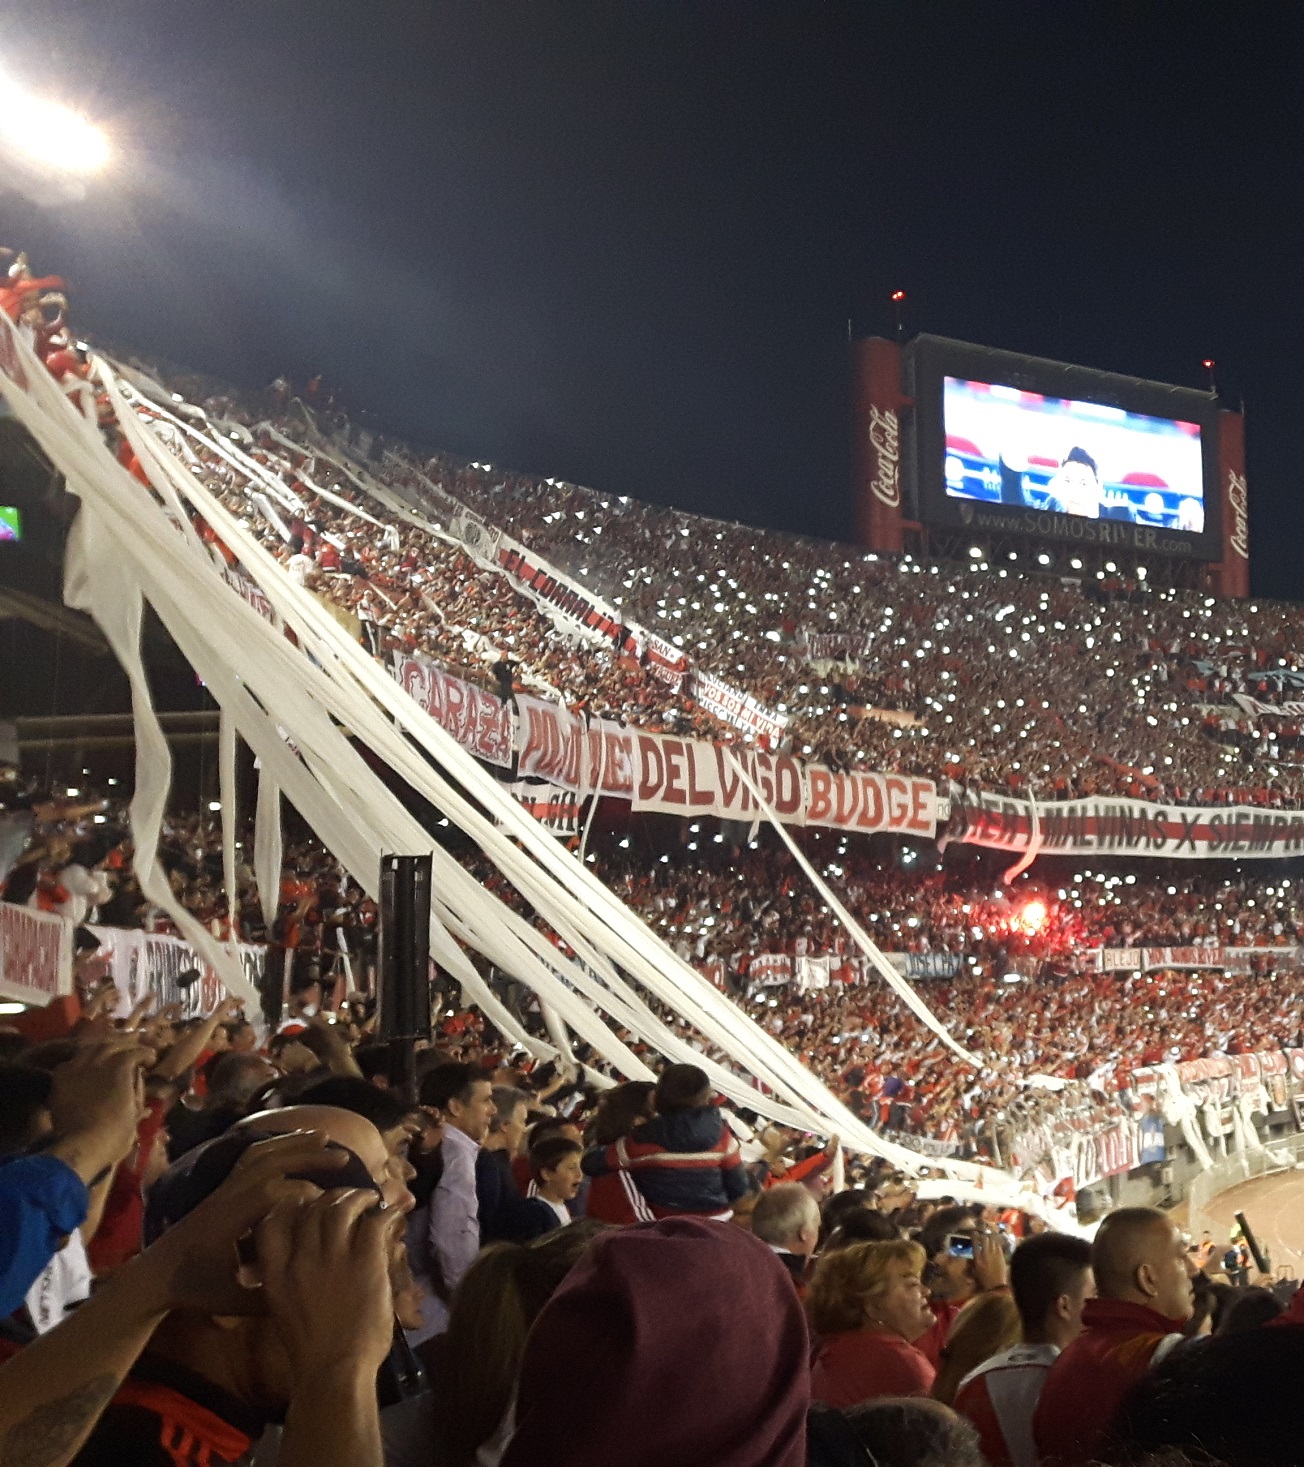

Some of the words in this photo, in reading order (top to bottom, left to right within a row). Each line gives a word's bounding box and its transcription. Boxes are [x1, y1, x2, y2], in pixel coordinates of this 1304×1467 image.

[703, 683, 721, 702] VOS
[721, 693, 741, 713] SOS
[638, 735, 715, 807] DEL
[807, 776, 934, 832] BUDGE
[1045, 803, 1167, 849] MALVINAS
[1179, 811, 1198, 852] X
